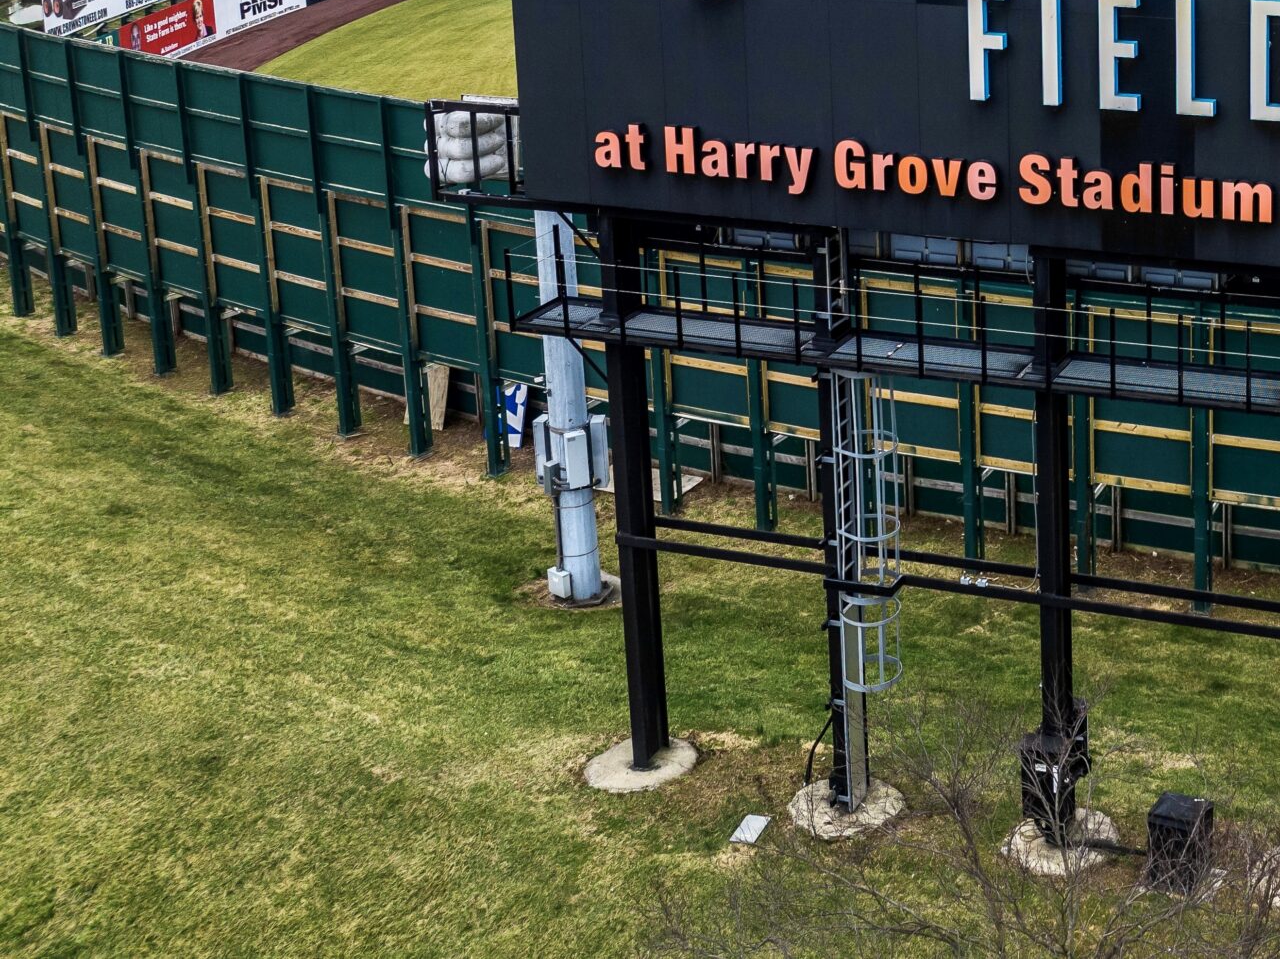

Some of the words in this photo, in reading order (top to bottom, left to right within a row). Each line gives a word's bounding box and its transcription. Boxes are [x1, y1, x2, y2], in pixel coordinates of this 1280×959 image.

[144, 23, 154, 33] Like
[157, 16, 169, 28] good
[168, 10, 188, 24] neighbor,
[146, 33, 158, 42] State
[158, 28, 170, 38] Farm
[594, 121, 646, 172] at
[663, 124, 816, 197] Harry
[833, 137, 999, 203] Grove
[1017, 151, 1276, 226] Stadium
